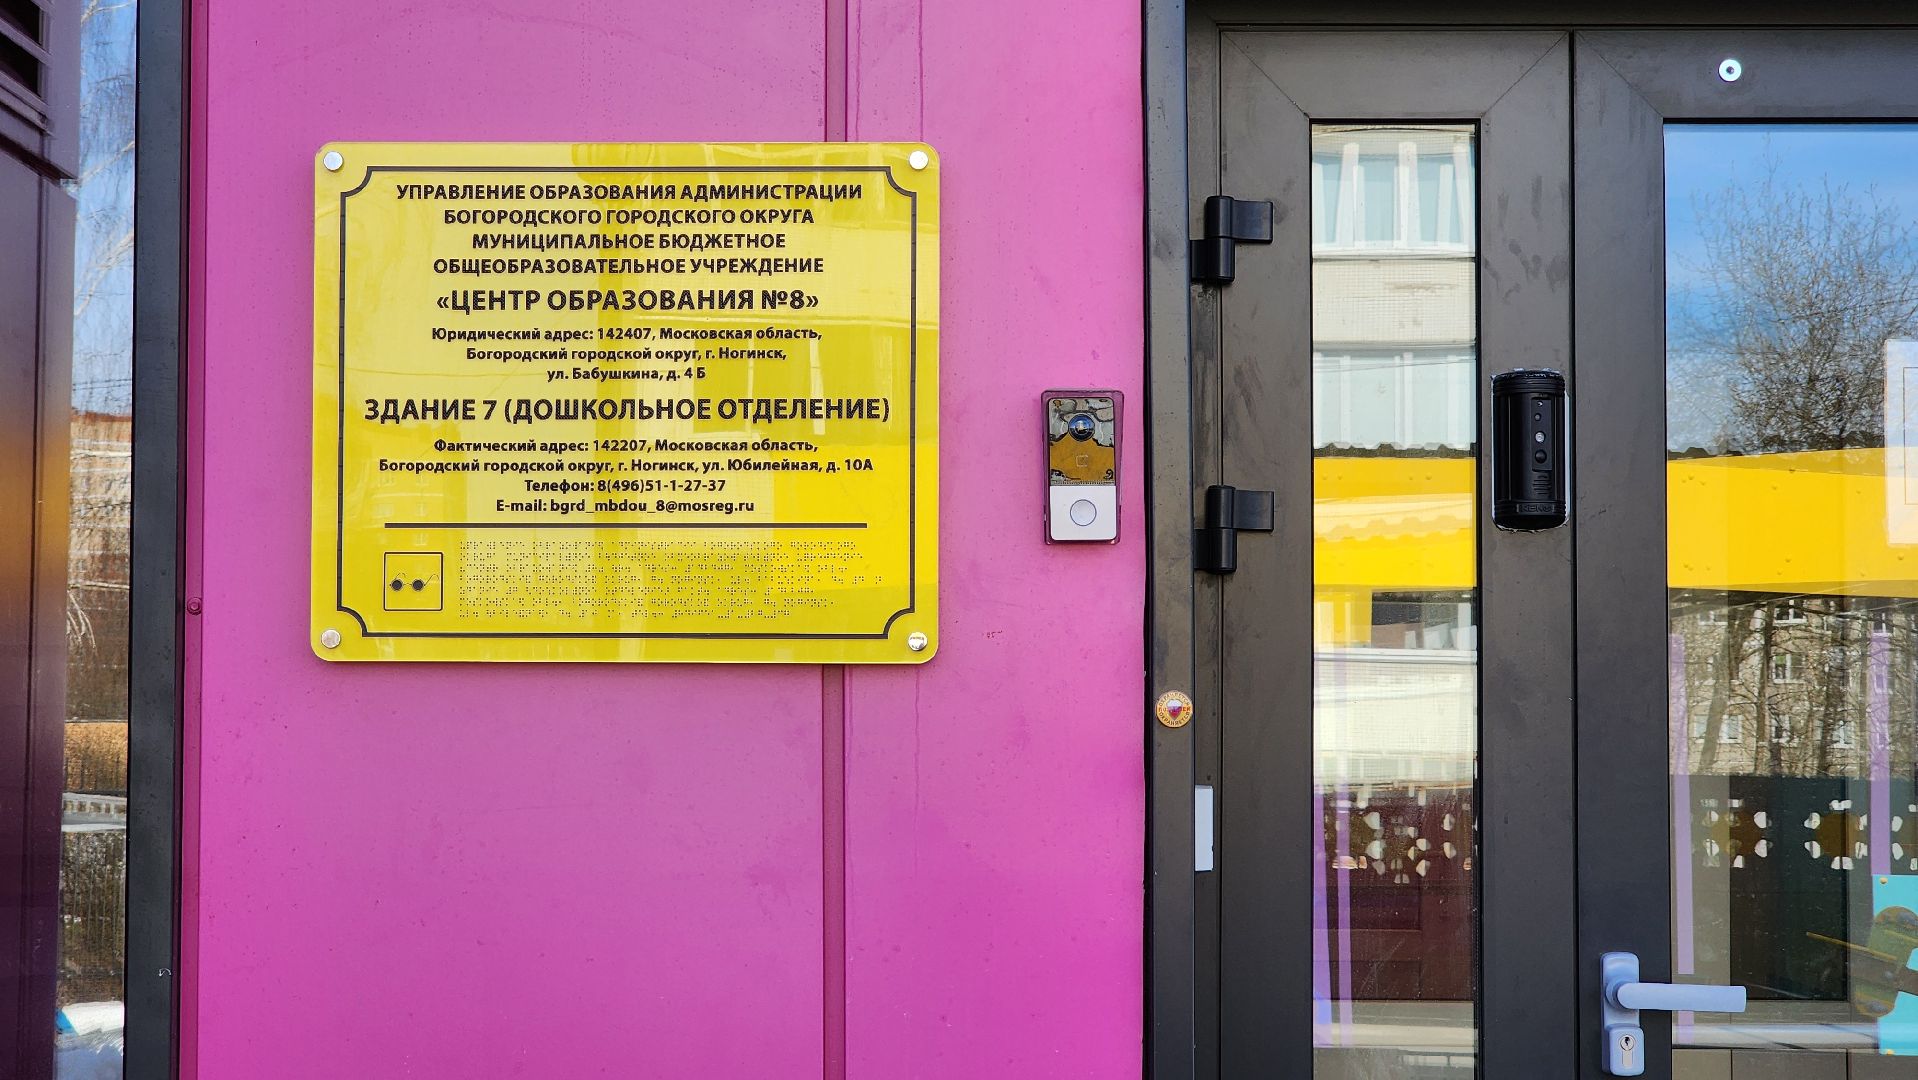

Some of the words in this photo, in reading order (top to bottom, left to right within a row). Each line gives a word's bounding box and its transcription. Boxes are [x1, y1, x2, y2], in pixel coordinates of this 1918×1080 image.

[396, 184, 526, 201] УПРАВЛЕНИЕ
[529, 184, 676, 201] ОБРАЗОВАНИЯ
[679, 184, 862, 203] АДМИНИСТРАЦИИ
[444, 209, 602, 228] БОГОРОДСКОГО
[606, 209, 736, 228] ГОРОДСКОГО
[739, 208, 815, 224] ОКРУГА
[472, 233, 655, 253] МУНИЦИПАЛЬНОЕ
[658, 233, 786, 253] БЮДЖЕТНОЕ
[433, 258, 686, 278] ОБЩЕОБРАЗОВАТЕЛЬНОЕ
[689, 257, 824, 277] УЧРЕЖДЕНИЕ
[436, 289, 541, 316] «ЦЕНТР
[547, 289, 754, 311] ОБРАЗОВАНИЯ
[761, 289, 819, 310] №8»
[431, 327, 541, 343] Юридический
[543, 330, 594, 343] адрес:
[597, 327, 656, 341] 142407,
[659, 327, 753, 340] Московская
[755, 326, 823, 341] область,
[466, 347, 568, 363] Богородский
[571, 347, 652, 363] городской
[654, 349, 702, 363] округ,
[705, 349, 716, 360] г.
[718, 346, 787, 361] Ногинск,
[546, 370, 569, 383] ул.
[572, 366, 664, 383] Бабушкина,
[665, 369, 681, 382] д.
[683, 367, 694, 379] 4
[696, 366, 706, 379] Б
[364, 398, 476, 425] ЗДАНИЕ
[482, 399, 498, 421] 7
[504, 398, 712, 425] (ДОШКОЛЬНОЕ
[717, 397, 890, 425] ОТДЕЛЕНИЕ)
[433, 438, 537, 453] Фактический
[539, 442, 589, 455] адрес:
[593, 439, 652, 454] 142207,
[654, 438, 748, 452] Московская
[751, 437, 819, 453] область,
[379, 458, 480, 475] Богородский
[483, 458, 565, 475] городской
[567, 462, 615, 475] округ,
[618, 462, 628, 472] г.
[630, 458, 700, 474] Ногинск,
[701, 461, 725, 475] ул.
[727, 457, 823, 474] Юбилейная,
[825, 461, 841, 475] д.
[844, 458, 874, 472] 10А
[524, 478, 595, 495] Телефон:
[597, 478, 726, 494] 8(496)51-1-27-37
[496, 498, 547, 512] E-mail:
[550, 498, 755, 515] bgrd_mbdou_8@mosreg.ru
